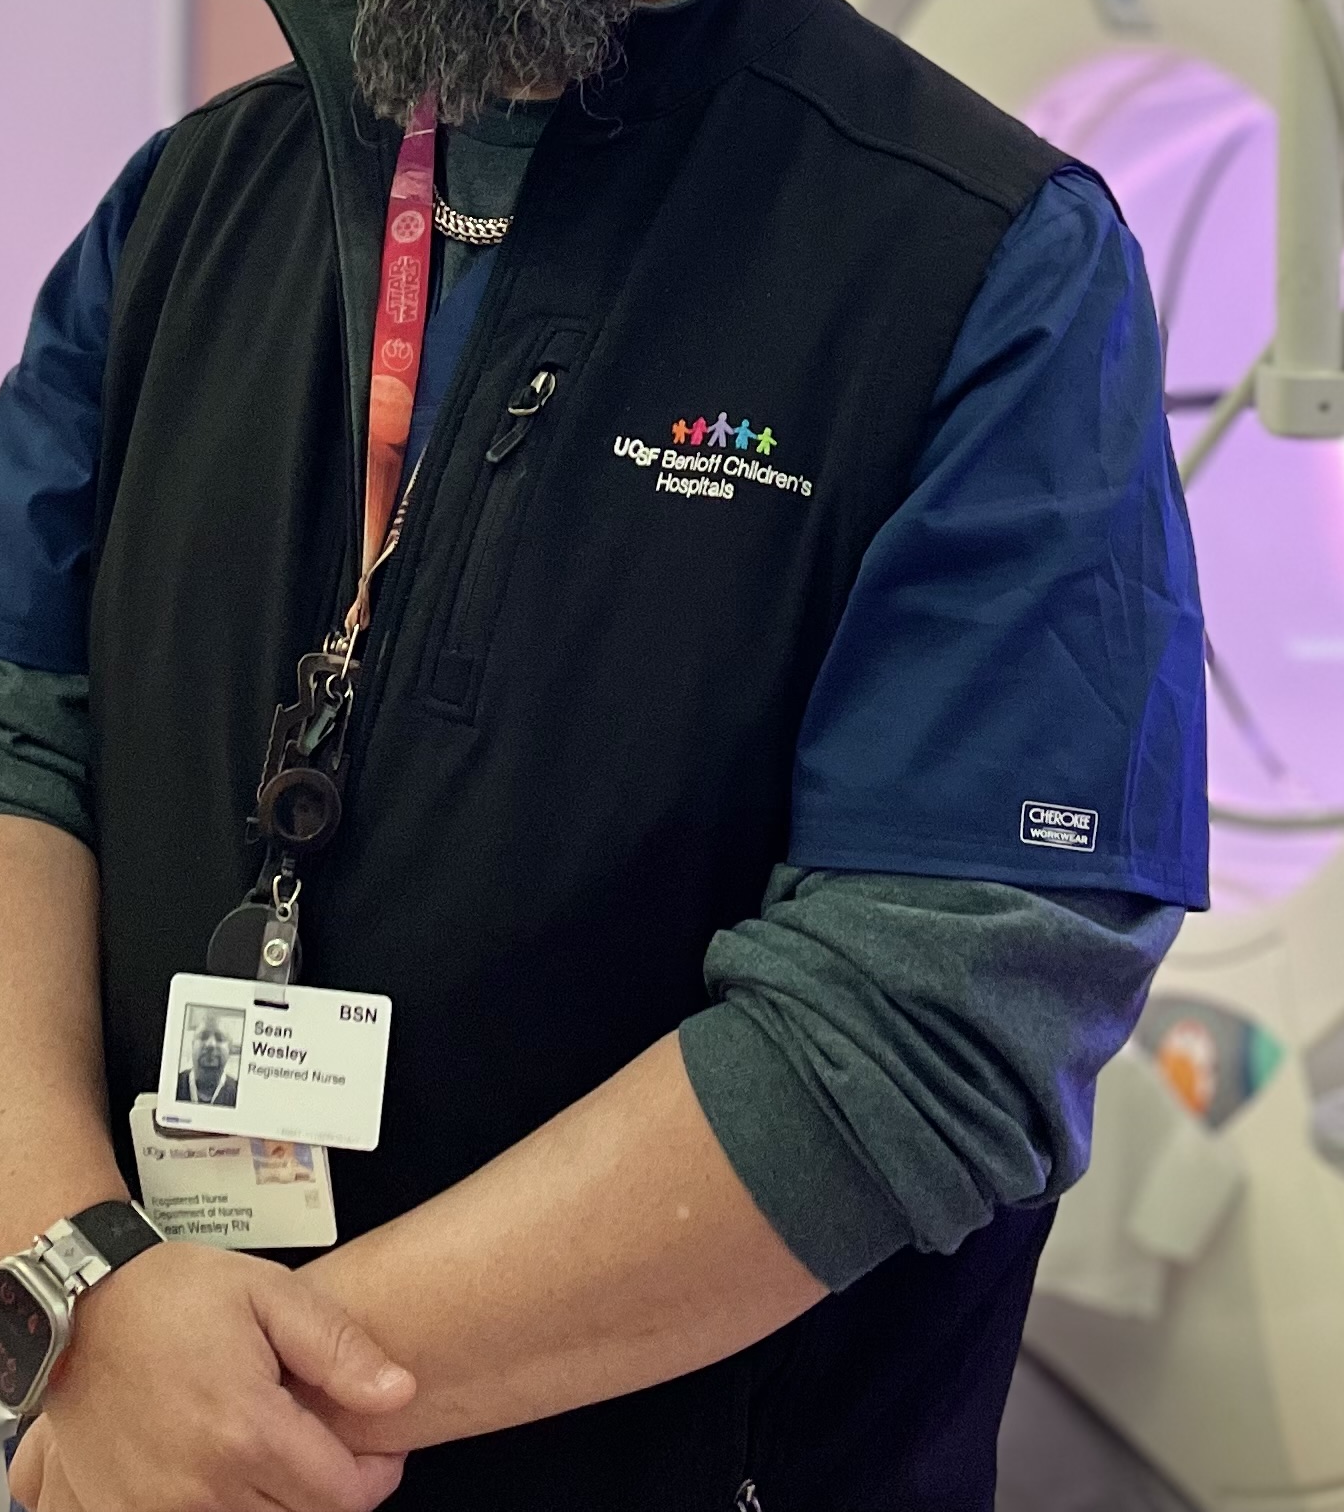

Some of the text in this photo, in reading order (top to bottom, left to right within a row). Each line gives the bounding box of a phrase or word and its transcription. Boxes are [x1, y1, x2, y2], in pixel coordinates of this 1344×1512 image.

[613, 436, 812, 497] UCSF Benioff Children's
[656, 472, 734, 500] Hospitals
[1029, 808, 1091, 830] CHEROKEE
[1030, 828, 1088, 844] WORKWEAR
[339, 1005, 378, 1025] BSN
[254, 1021, 293, 1039] Sean
[252, 1042, 308, 1065] Wesley
[247, 1063, 346, 1086] Registered Nurse
[187, 1220, 229, 1235] Wesley
[231, 1219, 250, 1233] RN
